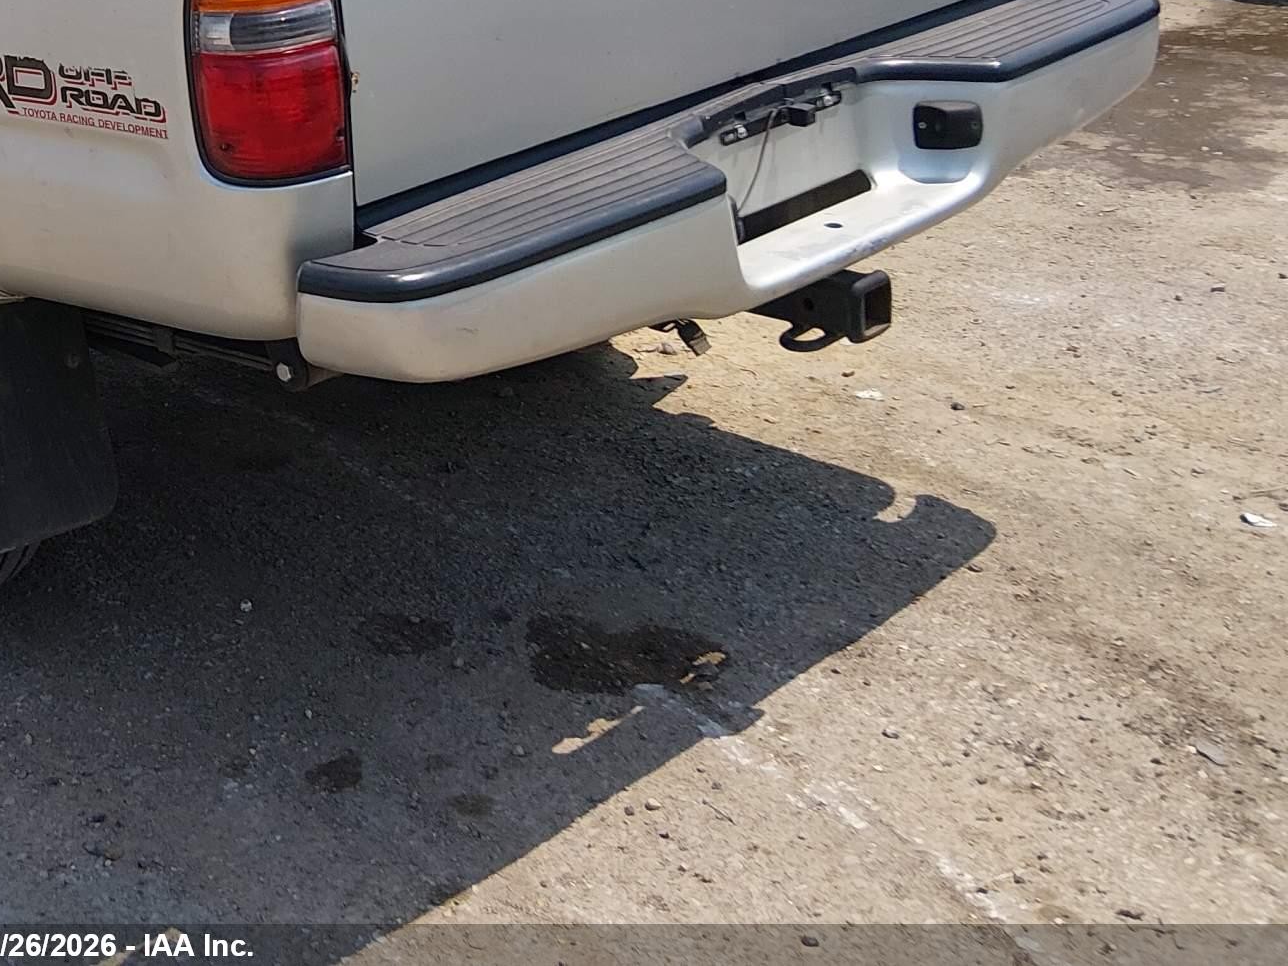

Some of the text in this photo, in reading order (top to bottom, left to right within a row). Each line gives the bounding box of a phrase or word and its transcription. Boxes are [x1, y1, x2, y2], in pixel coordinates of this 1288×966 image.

[58, 62, 132, 90] OFF
[60, 86, 166, 123] ROAD
[22, 106, 169, 139] TOYOTA RACING DEVELOPMENT
